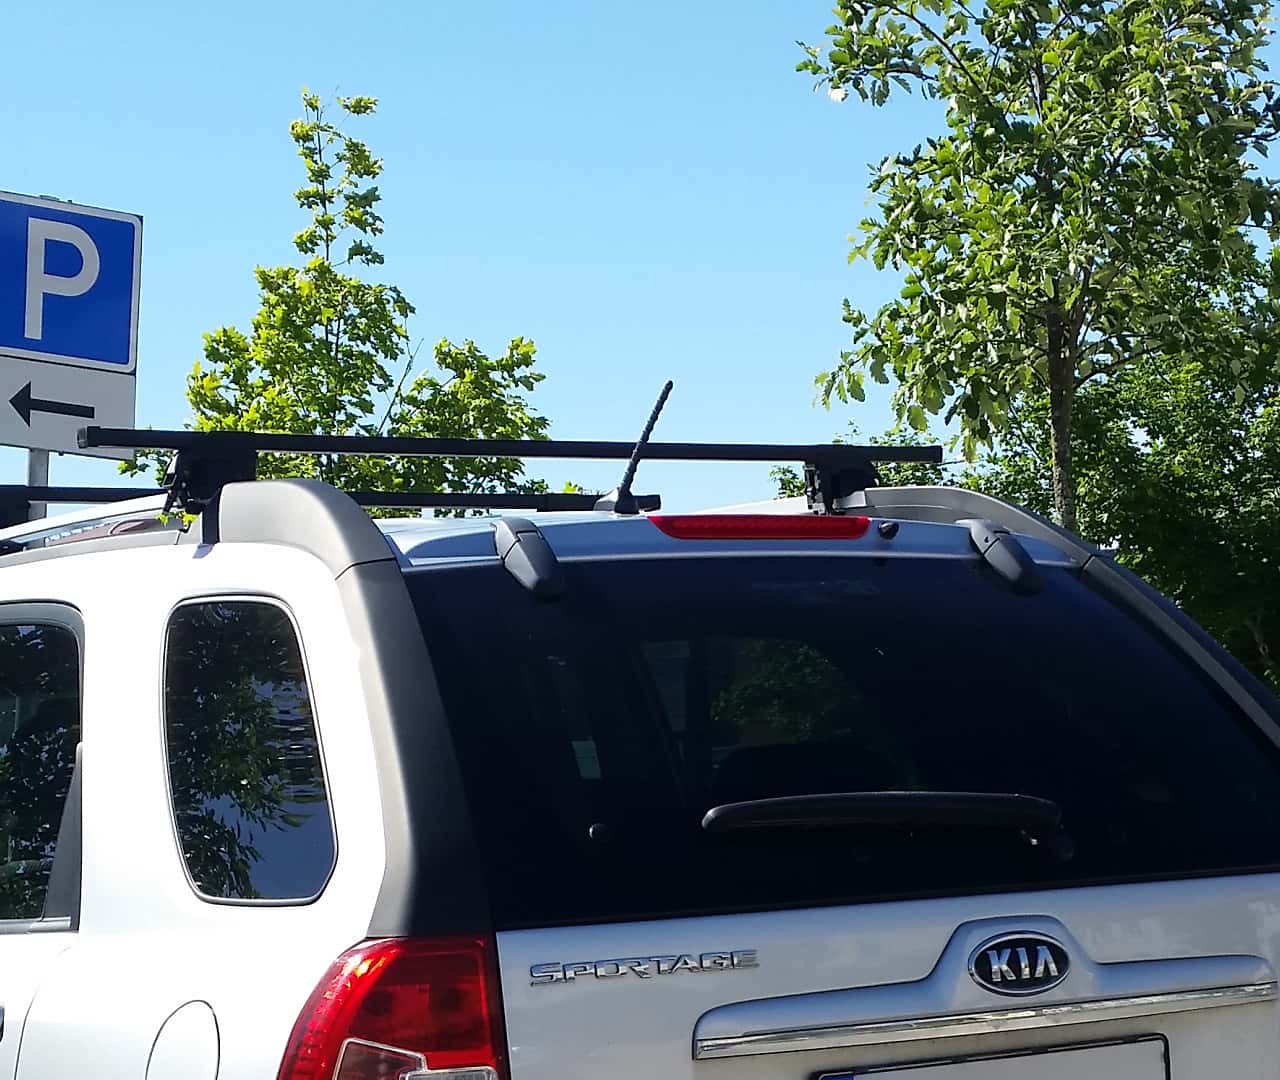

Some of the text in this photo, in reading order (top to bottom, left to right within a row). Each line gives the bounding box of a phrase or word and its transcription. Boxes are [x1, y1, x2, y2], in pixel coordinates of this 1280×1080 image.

[24, 216, 101, 341] P
[529, 949, 760, 987] SPORTAGE
[985, 945, 1060, 982] KIA
